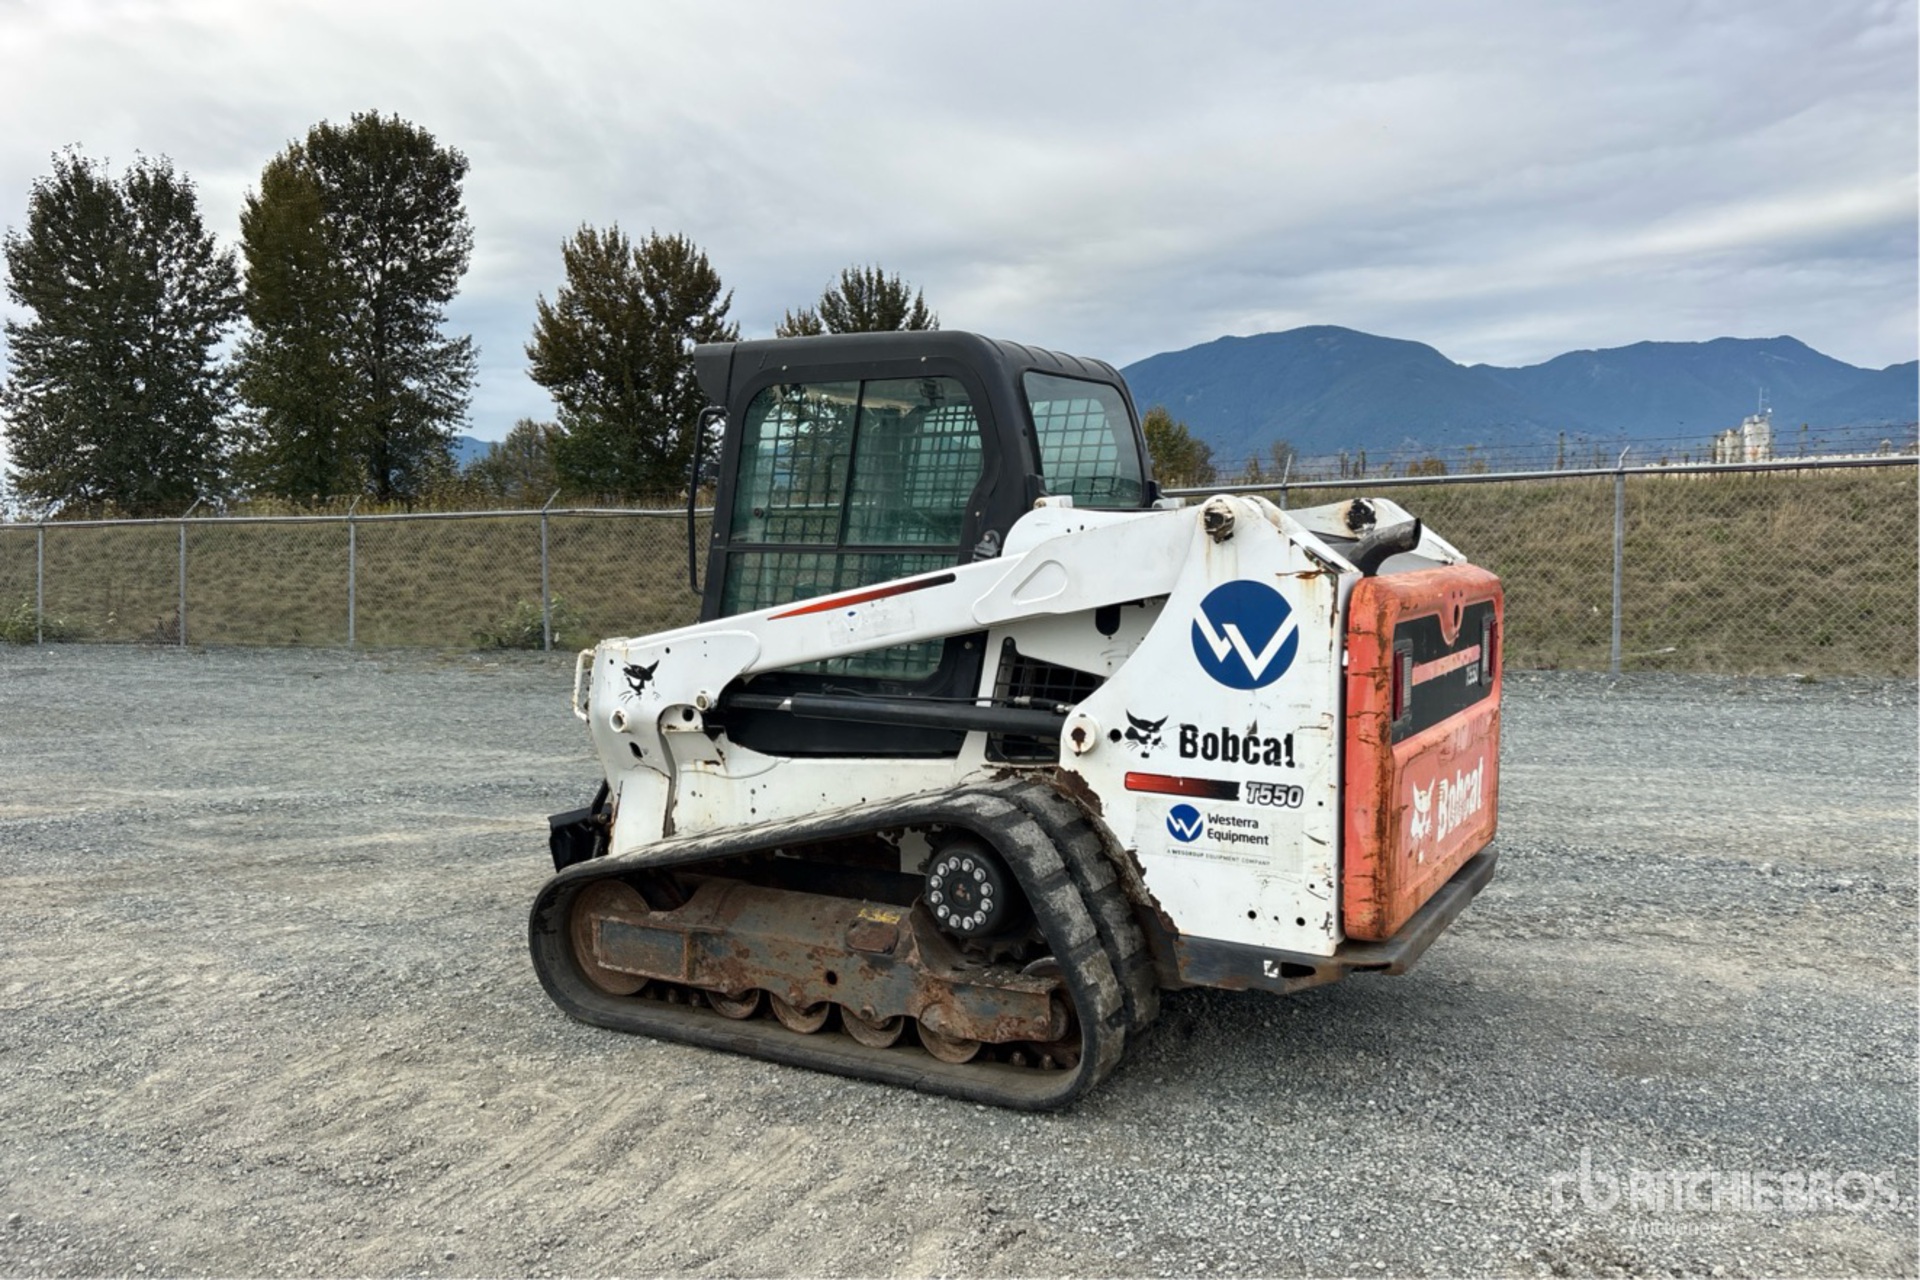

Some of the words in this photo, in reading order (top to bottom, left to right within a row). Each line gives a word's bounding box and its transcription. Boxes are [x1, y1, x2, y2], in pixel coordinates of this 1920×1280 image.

[1179, 723, 1295, 769] Bobcat
[1246, 781, 1304, 809] T550
[1437, 757, 1484, 843] Bobcat
[1207, 813, 1259, 829] Westerra
[1207, 828, 1269, 846] Equipment
[1205, 853, 1240, 863] EQUIPMENT
[1241, 857, 1270, 866] COMPANY
